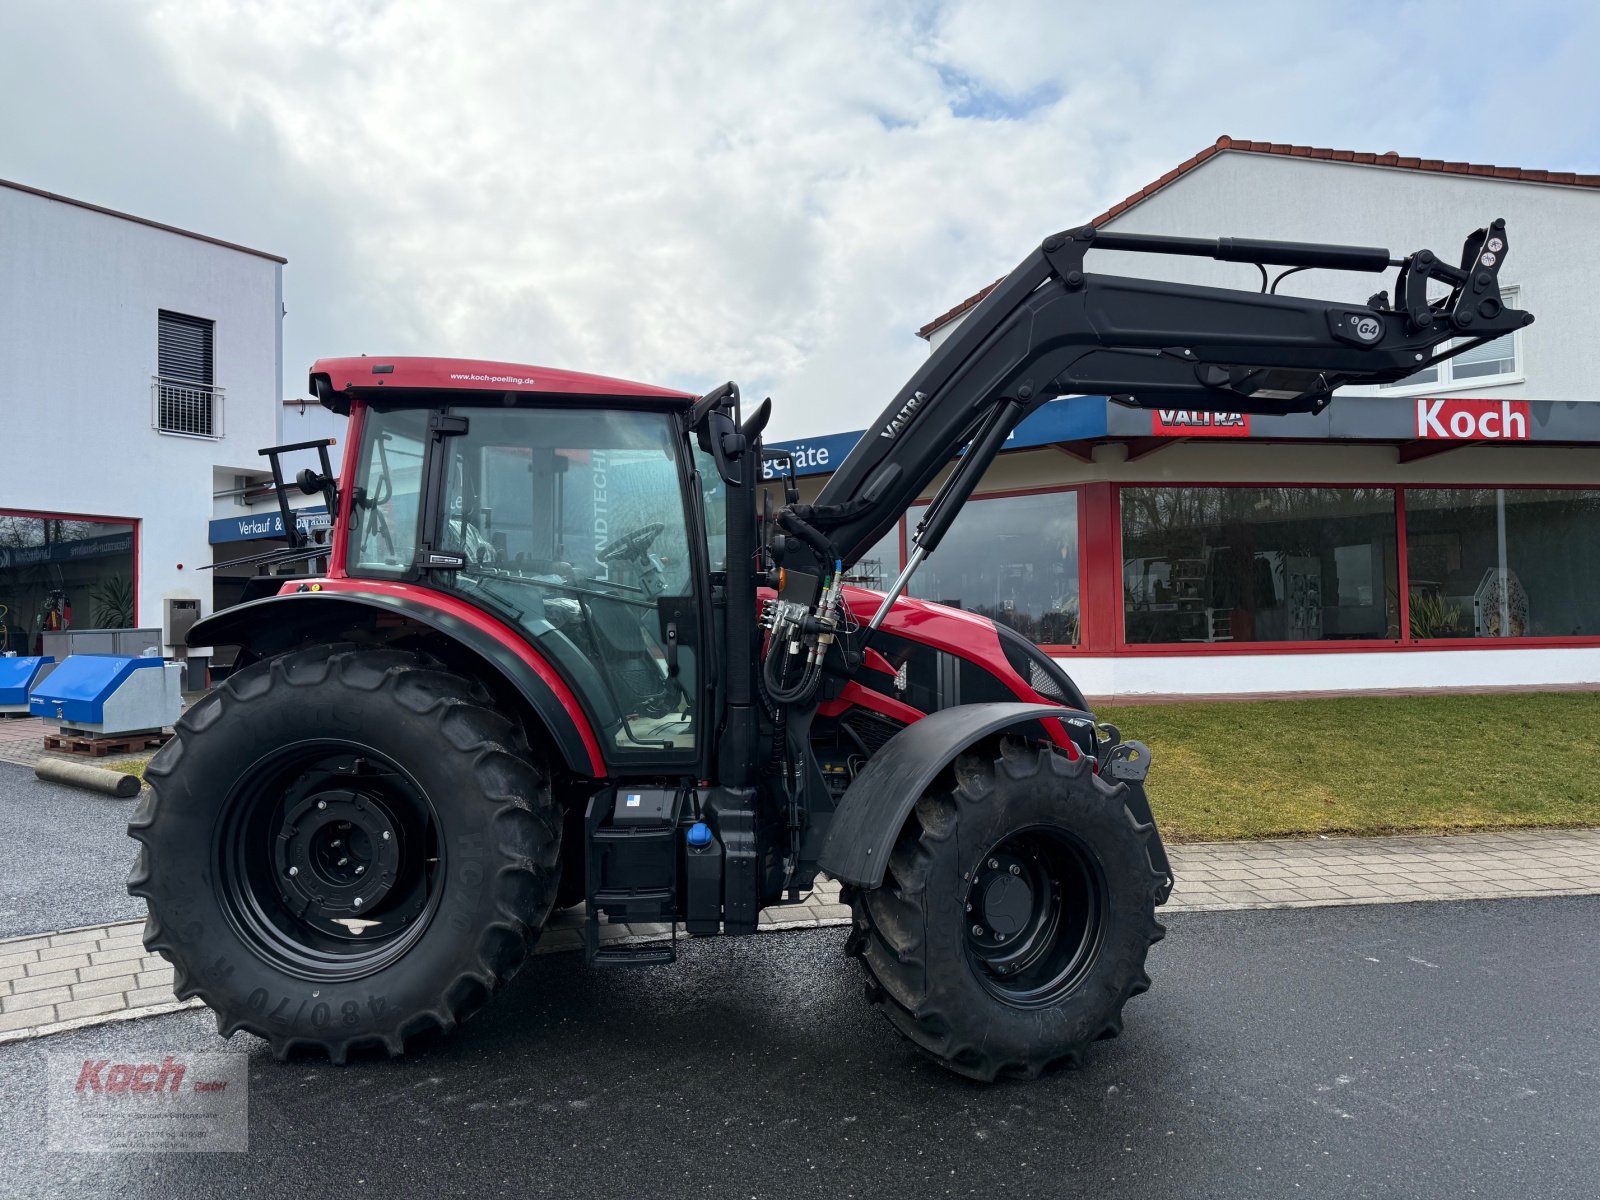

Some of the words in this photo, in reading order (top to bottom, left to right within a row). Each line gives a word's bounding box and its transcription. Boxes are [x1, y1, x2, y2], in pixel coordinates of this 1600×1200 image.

[1359, 323, 1378, 335] G4
[450, 373, 535, 385] www.koch-poelling.de
[880, 390, 928, 439] VALTRA
[1158, 409, 1245, 426] VALTRA
[1417, 399, 1526, 438] Koch
[238, 518, 271, 535] Verkauf
[274, 517, 282, 531] &
